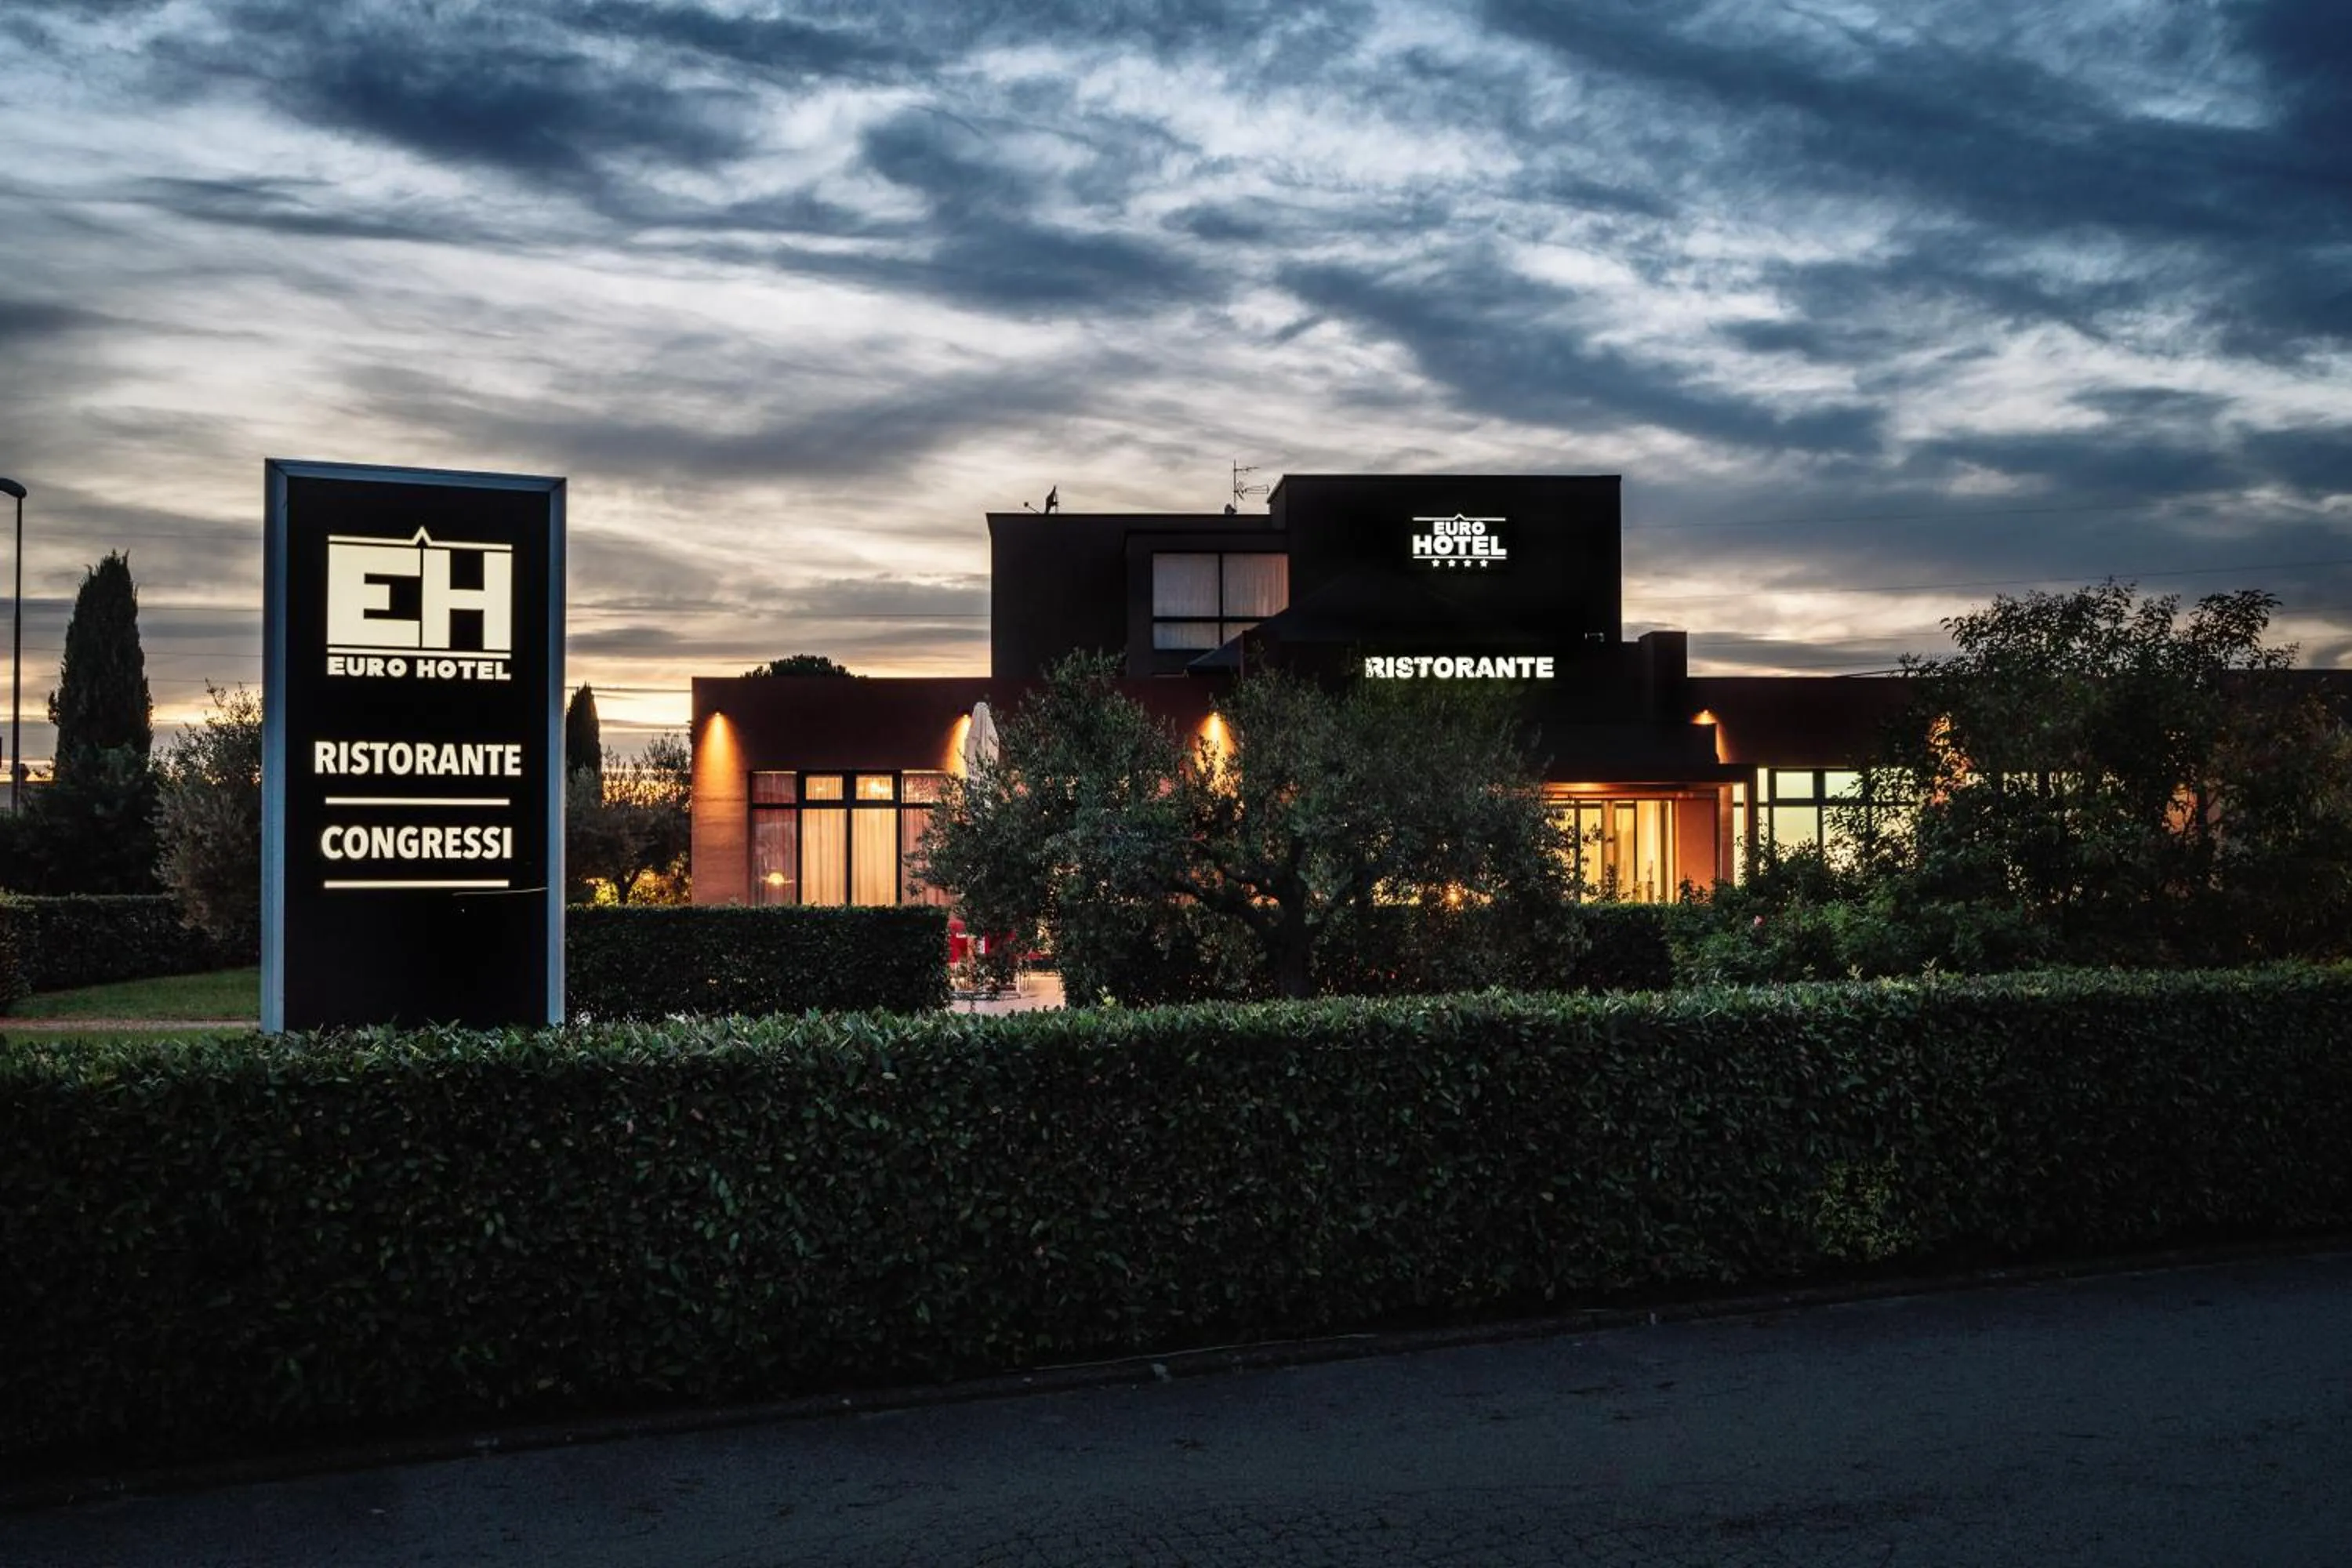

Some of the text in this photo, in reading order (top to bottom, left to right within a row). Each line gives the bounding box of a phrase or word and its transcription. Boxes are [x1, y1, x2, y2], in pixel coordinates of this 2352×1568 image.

[1432, 521, 1486, 536] EURO
[1412, 535, 1508, 556] HOTEL
[326, 543, 513, 652] EH
[327, 656, 511, 681] EURO HOTEL
[1365, 656, 1555, 679] RISTORANTE
[314, 741, 522, 775] RISTORANTE
[321, 826, 513, 859] CONGRESSI
